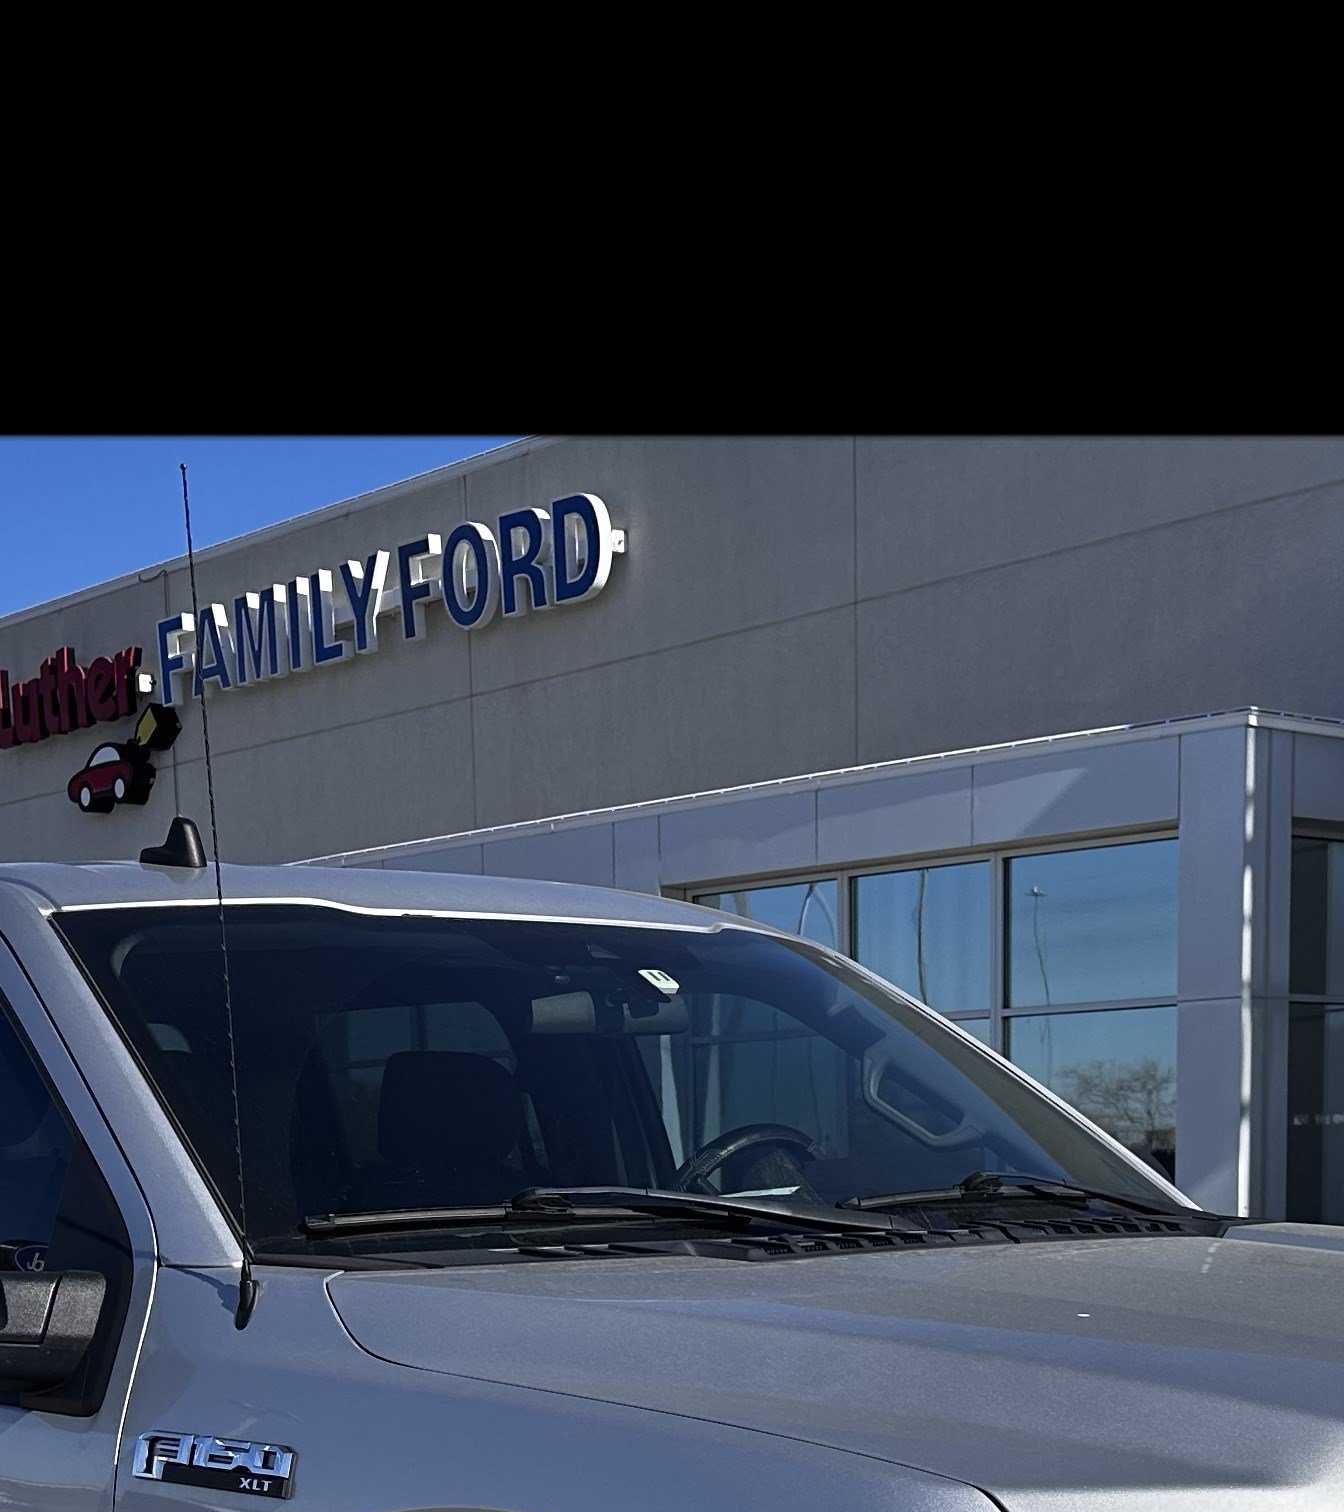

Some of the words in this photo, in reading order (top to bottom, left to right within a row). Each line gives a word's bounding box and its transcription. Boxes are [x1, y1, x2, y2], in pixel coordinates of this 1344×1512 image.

[157, 550, 391, 707] FAMILY
[399, 492, 613, 640] FORD
[238, 1477, 273, 1492] XLT
